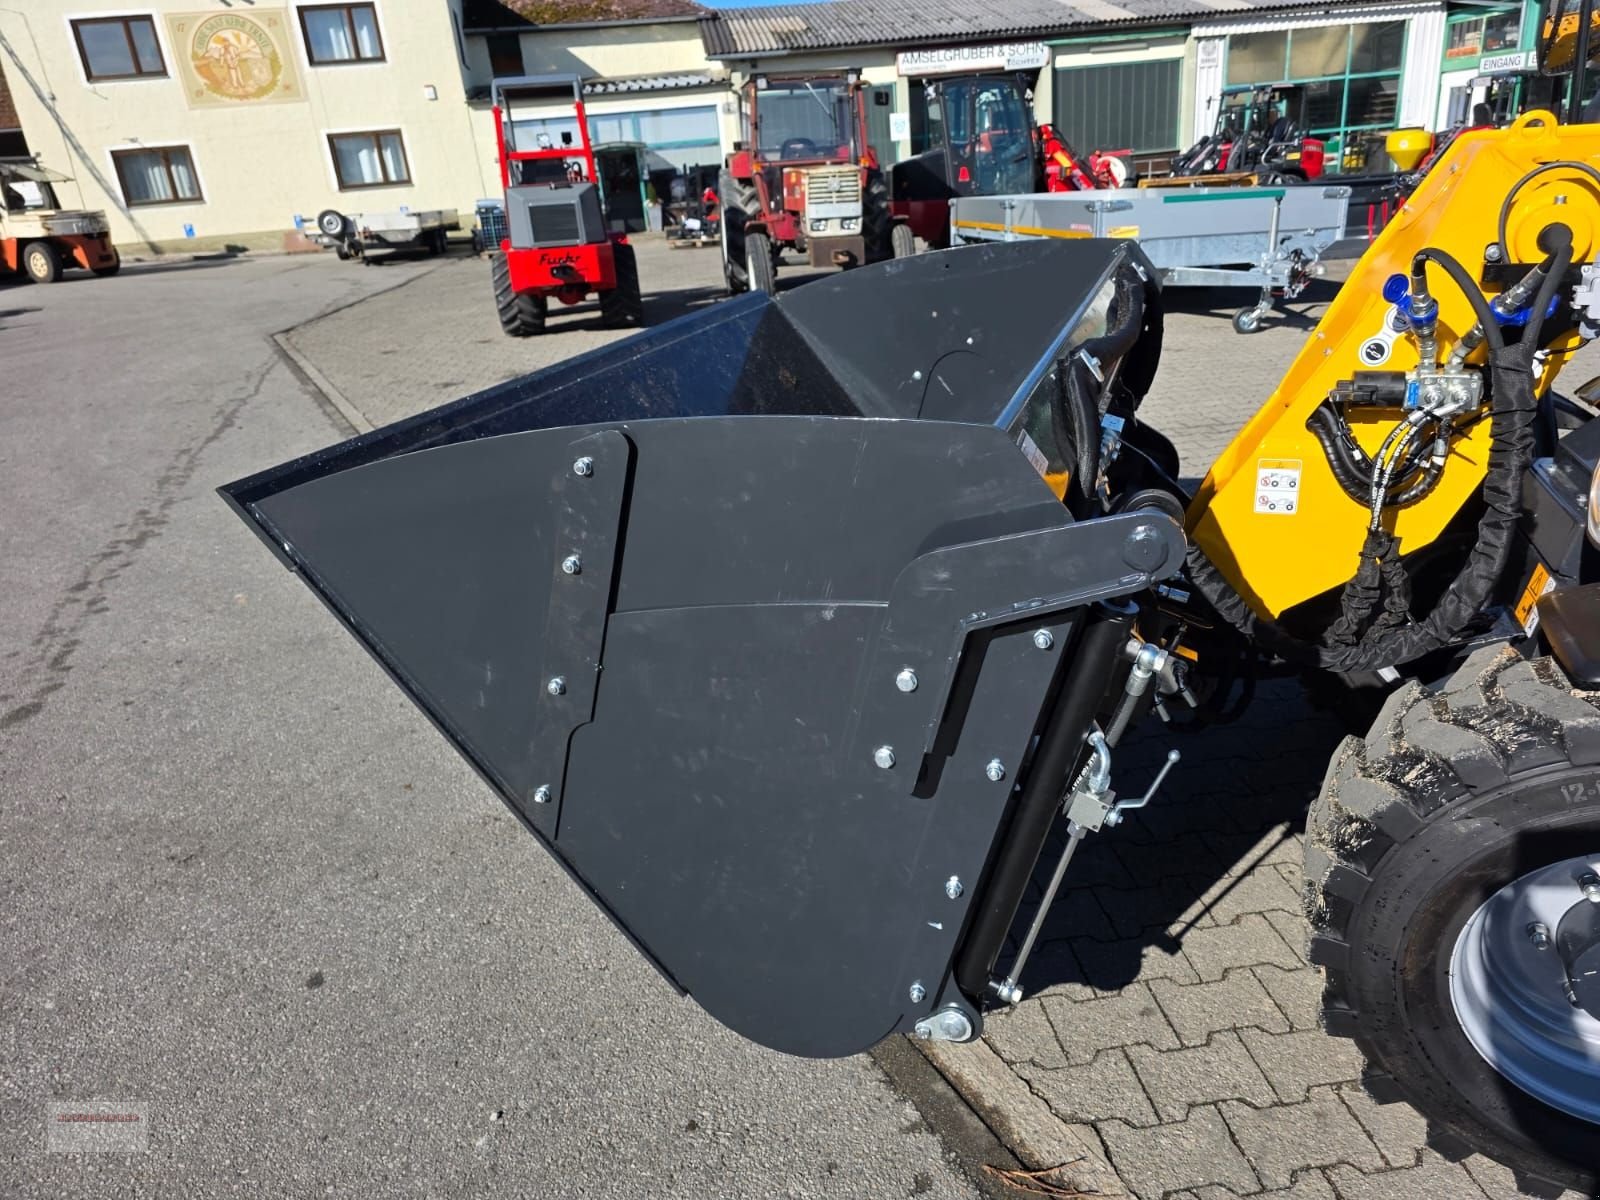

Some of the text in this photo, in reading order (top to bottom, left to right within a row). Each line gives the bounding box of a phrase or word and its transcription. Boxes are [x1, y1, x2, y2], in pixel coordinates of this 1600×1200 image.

[902, 42, 1044, 65] AMSELGRUBER & SOHN
[1483, 55, 1521, 70] EINGANG
